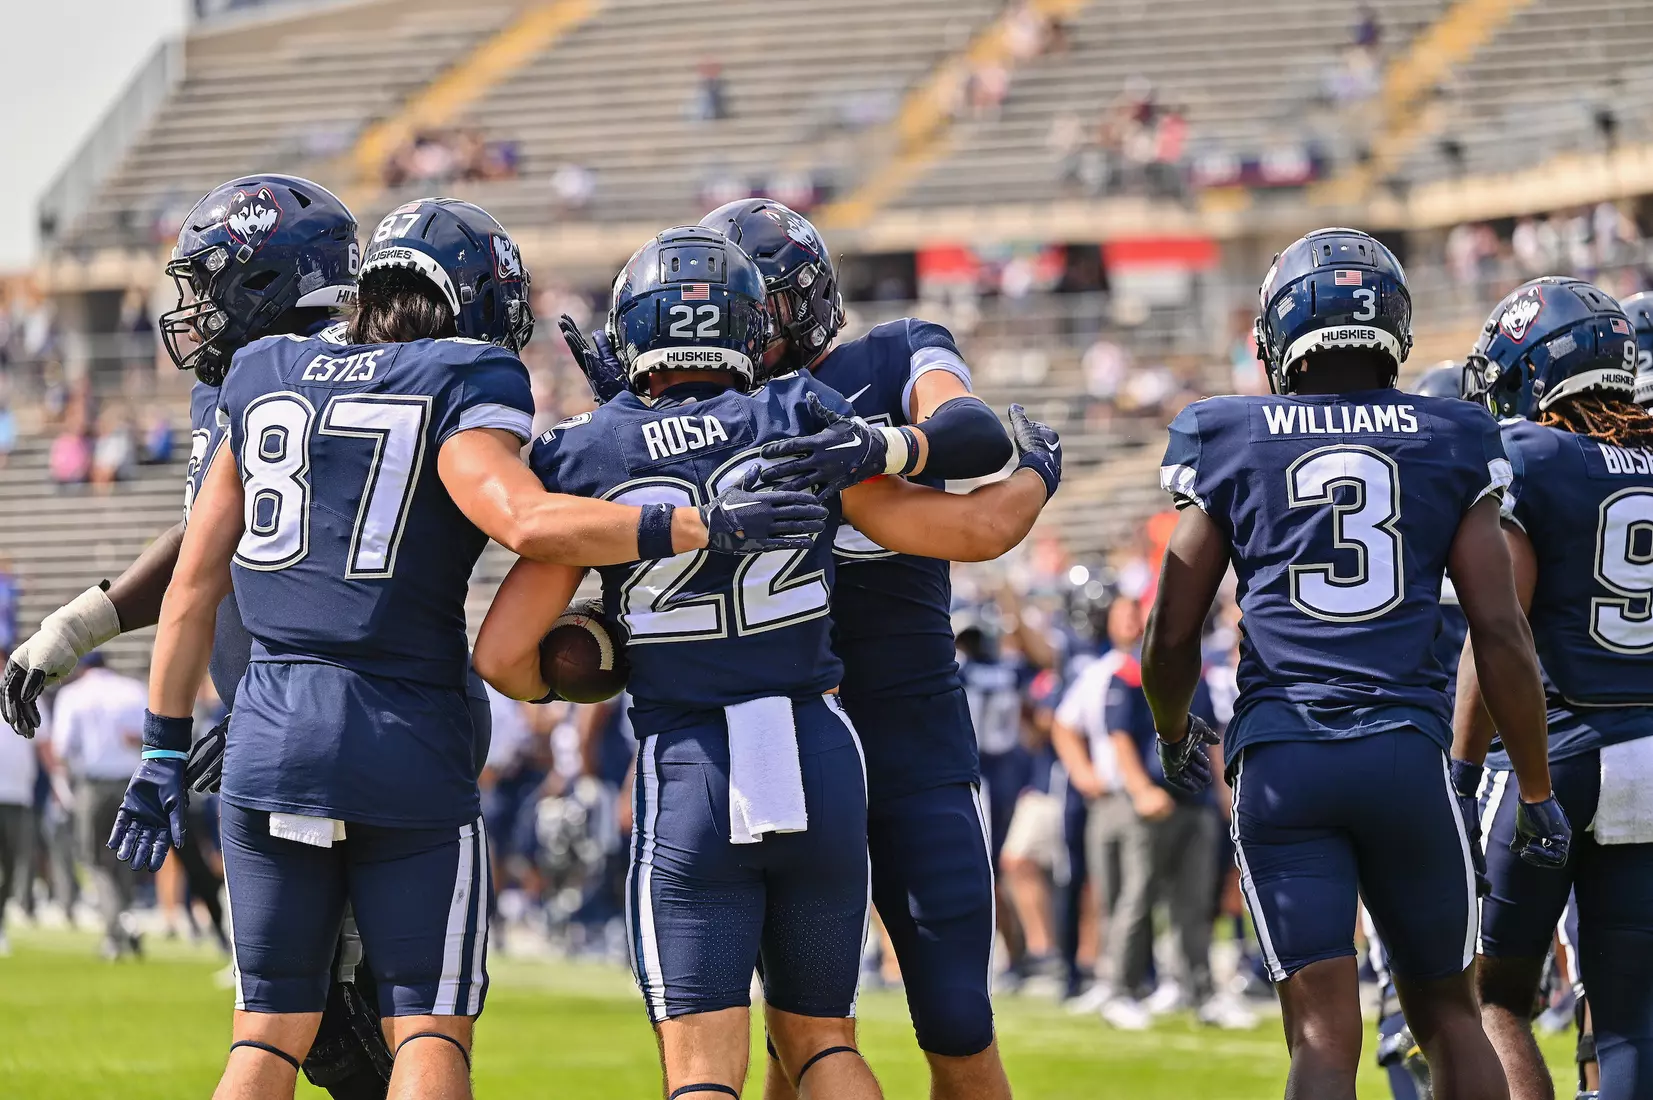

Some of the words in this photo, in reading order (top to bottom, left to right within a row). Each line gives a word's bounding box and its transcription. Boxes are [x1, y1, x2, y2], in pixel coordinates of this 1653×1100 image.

[374, 213, 421, 242] 87
[366, 249, 412, 265] HUSKIES
[669, 304, 720, 338] 22
[1352, 288, 1376, 322] 3
[1321, 329, 1376, 342] HUSKIES
[301, 349, 384, 382] ESTES
[666, 352, 723, 362] HUSKIES
[1622, 340, 1635, 370] 9
[1262, 404, 1419, 435] WILLIAMS
[641, 414, 729, 461] ROSA
[232, 390, 433, 580] 87
[1286, 443, 1405, 623] 3
